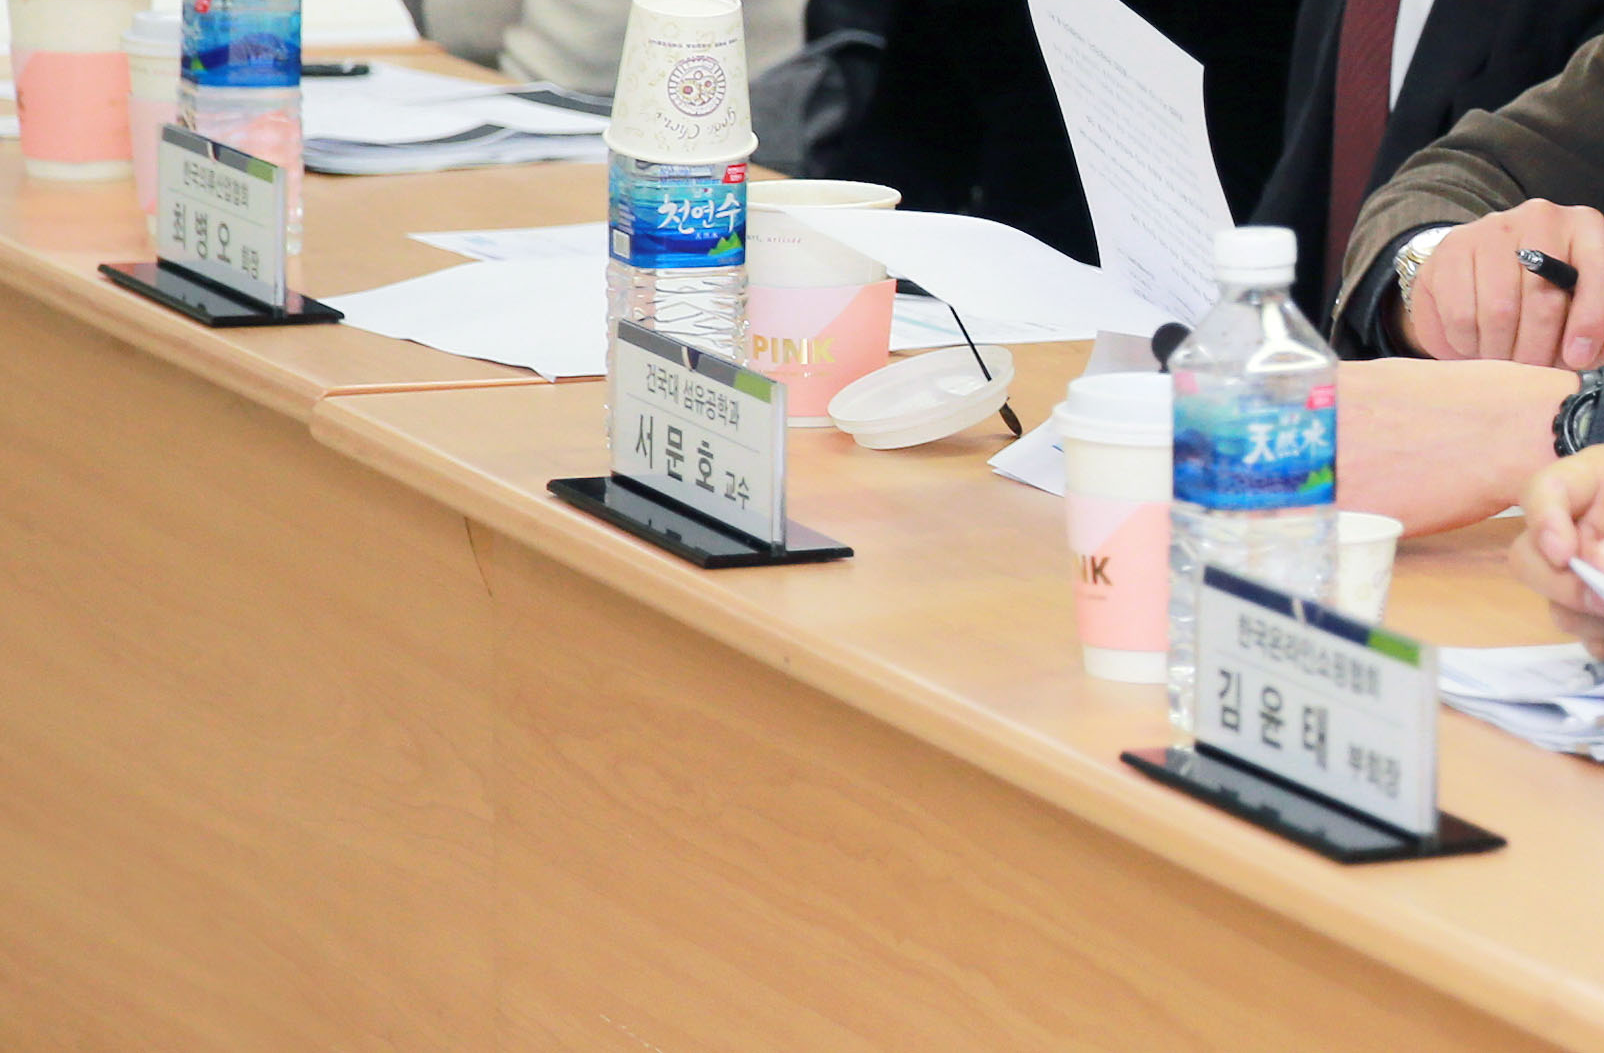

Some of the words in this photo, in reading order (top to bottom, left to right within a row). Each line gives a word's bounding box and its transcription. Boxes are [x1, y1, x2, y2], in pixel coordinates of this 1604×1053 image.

[657, 192, 742, 235] 천연수
[752, 333, 837, 365] PINK
[646, 363, 680, 405] 건국대
[683, 379, 740, 431] 섬유공학과
[635, 413, 715, 493] 서문호
[724, 470, 750, 510] 교수
